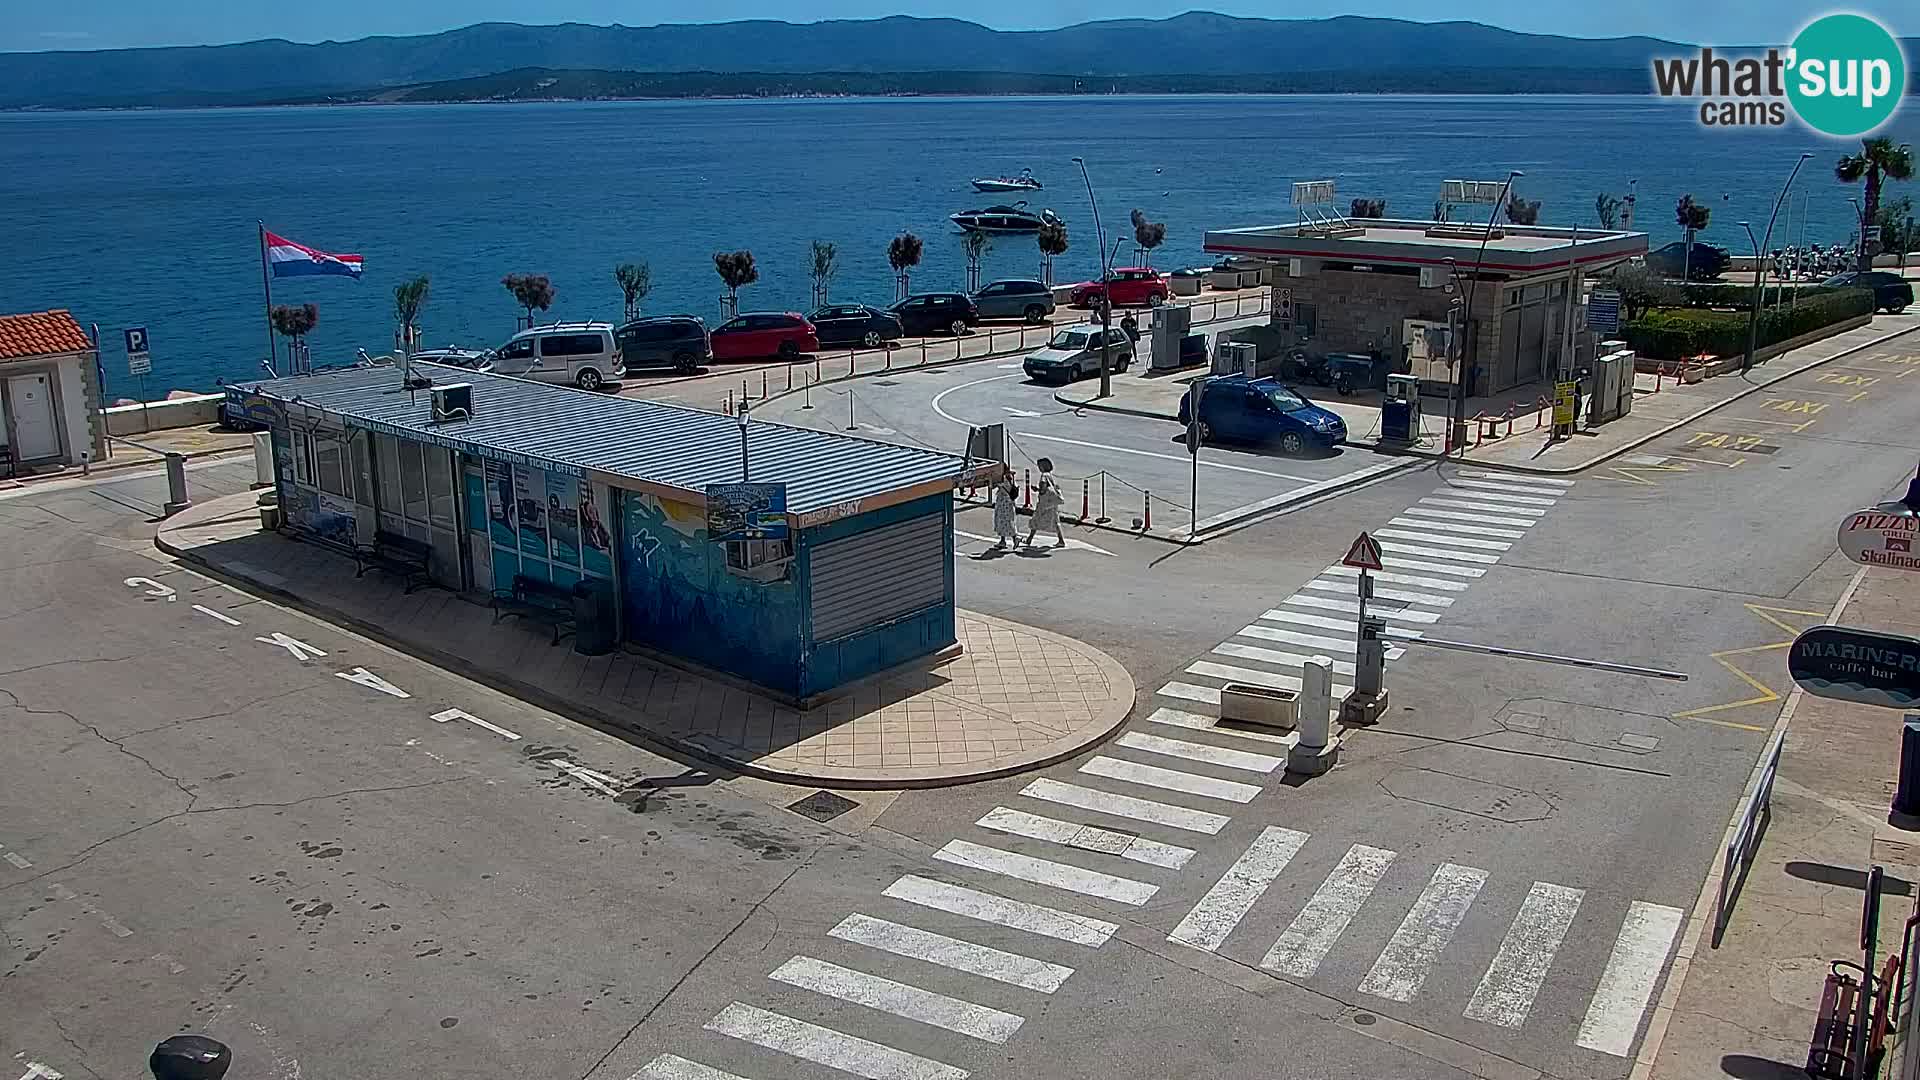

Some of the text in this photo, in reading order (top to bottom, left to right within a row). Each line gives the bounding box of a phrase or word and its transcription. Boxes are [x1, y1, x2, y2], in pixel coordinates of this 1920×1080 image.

[130, 331, 142, 350] P
[1816, 373, 1881, 388] TAXI
[1760, 398, 1831, 415] TAXI
[1685, 431, 1765, 451] TAXI
[478, 447, 493, 458] BUS
[494, 449, 526, 465] STATION
[527, 457, 554, 471] TICKET
[555, 461, 582, 477] OFFICE
[1848, 515, 1920, 532] PIZZE
[1829, 661, 1897, 680] caffe bar
